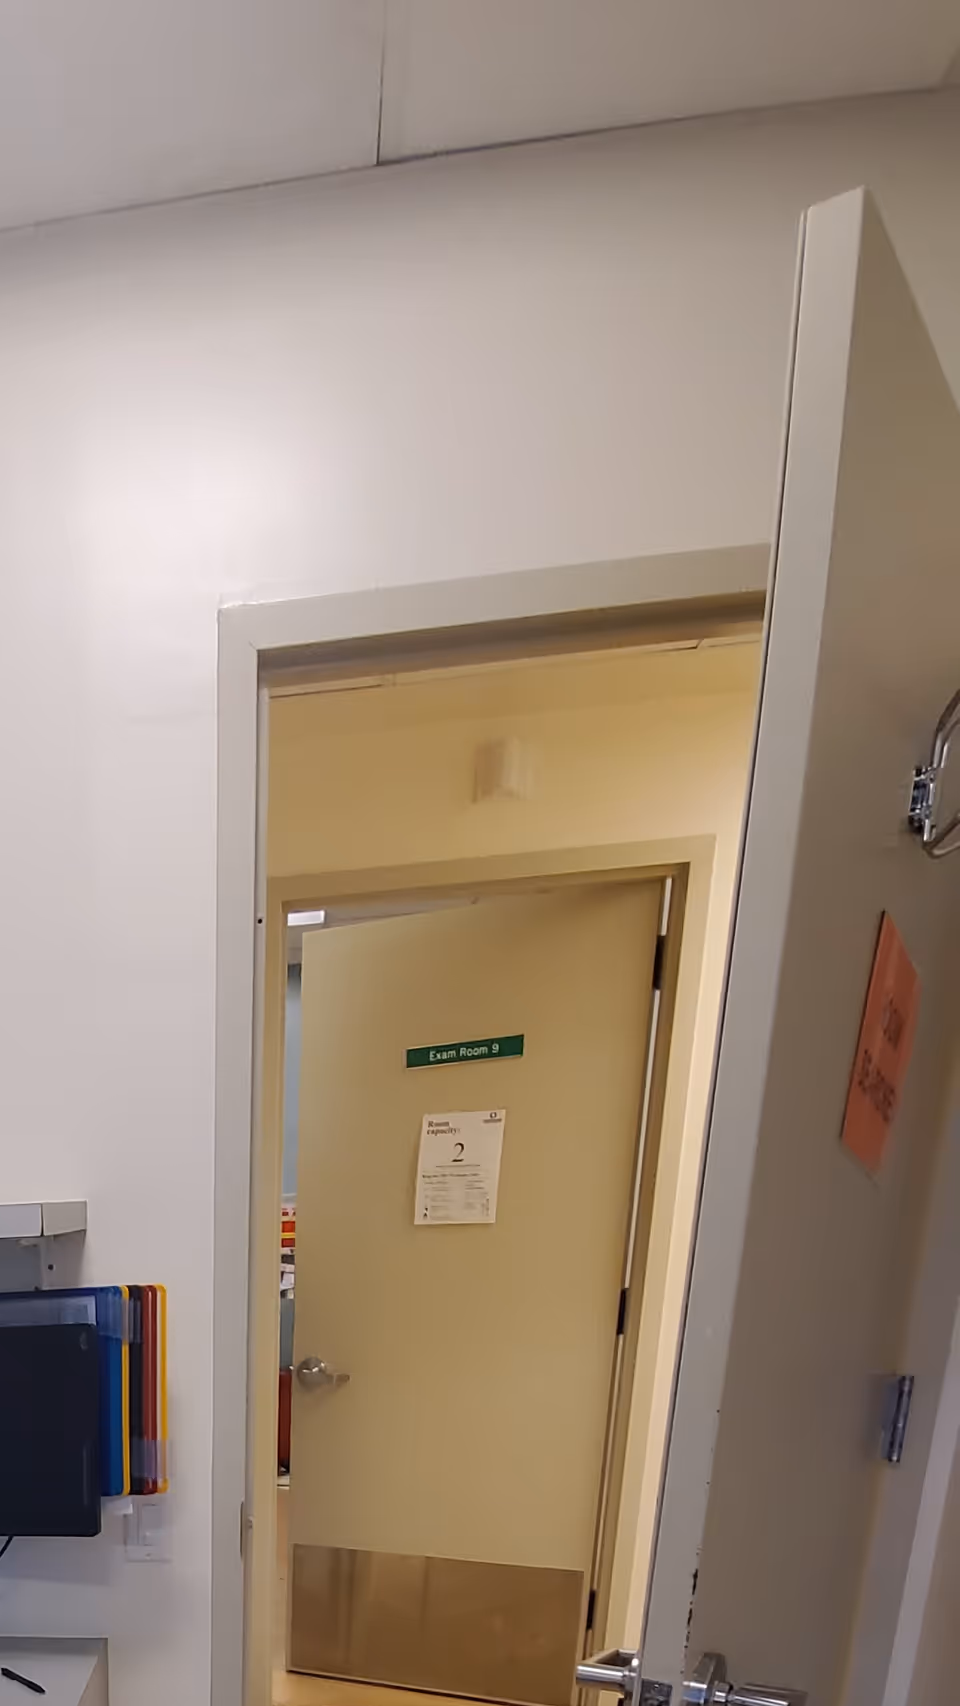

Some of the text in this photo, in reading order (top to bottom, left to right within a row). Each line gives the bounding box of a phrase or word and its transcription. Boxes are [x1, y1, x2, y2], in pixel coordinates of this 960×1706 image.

[429, 1043, 500, 1062] Exam Room 9
[451, 1142, 465, 1163] 2
